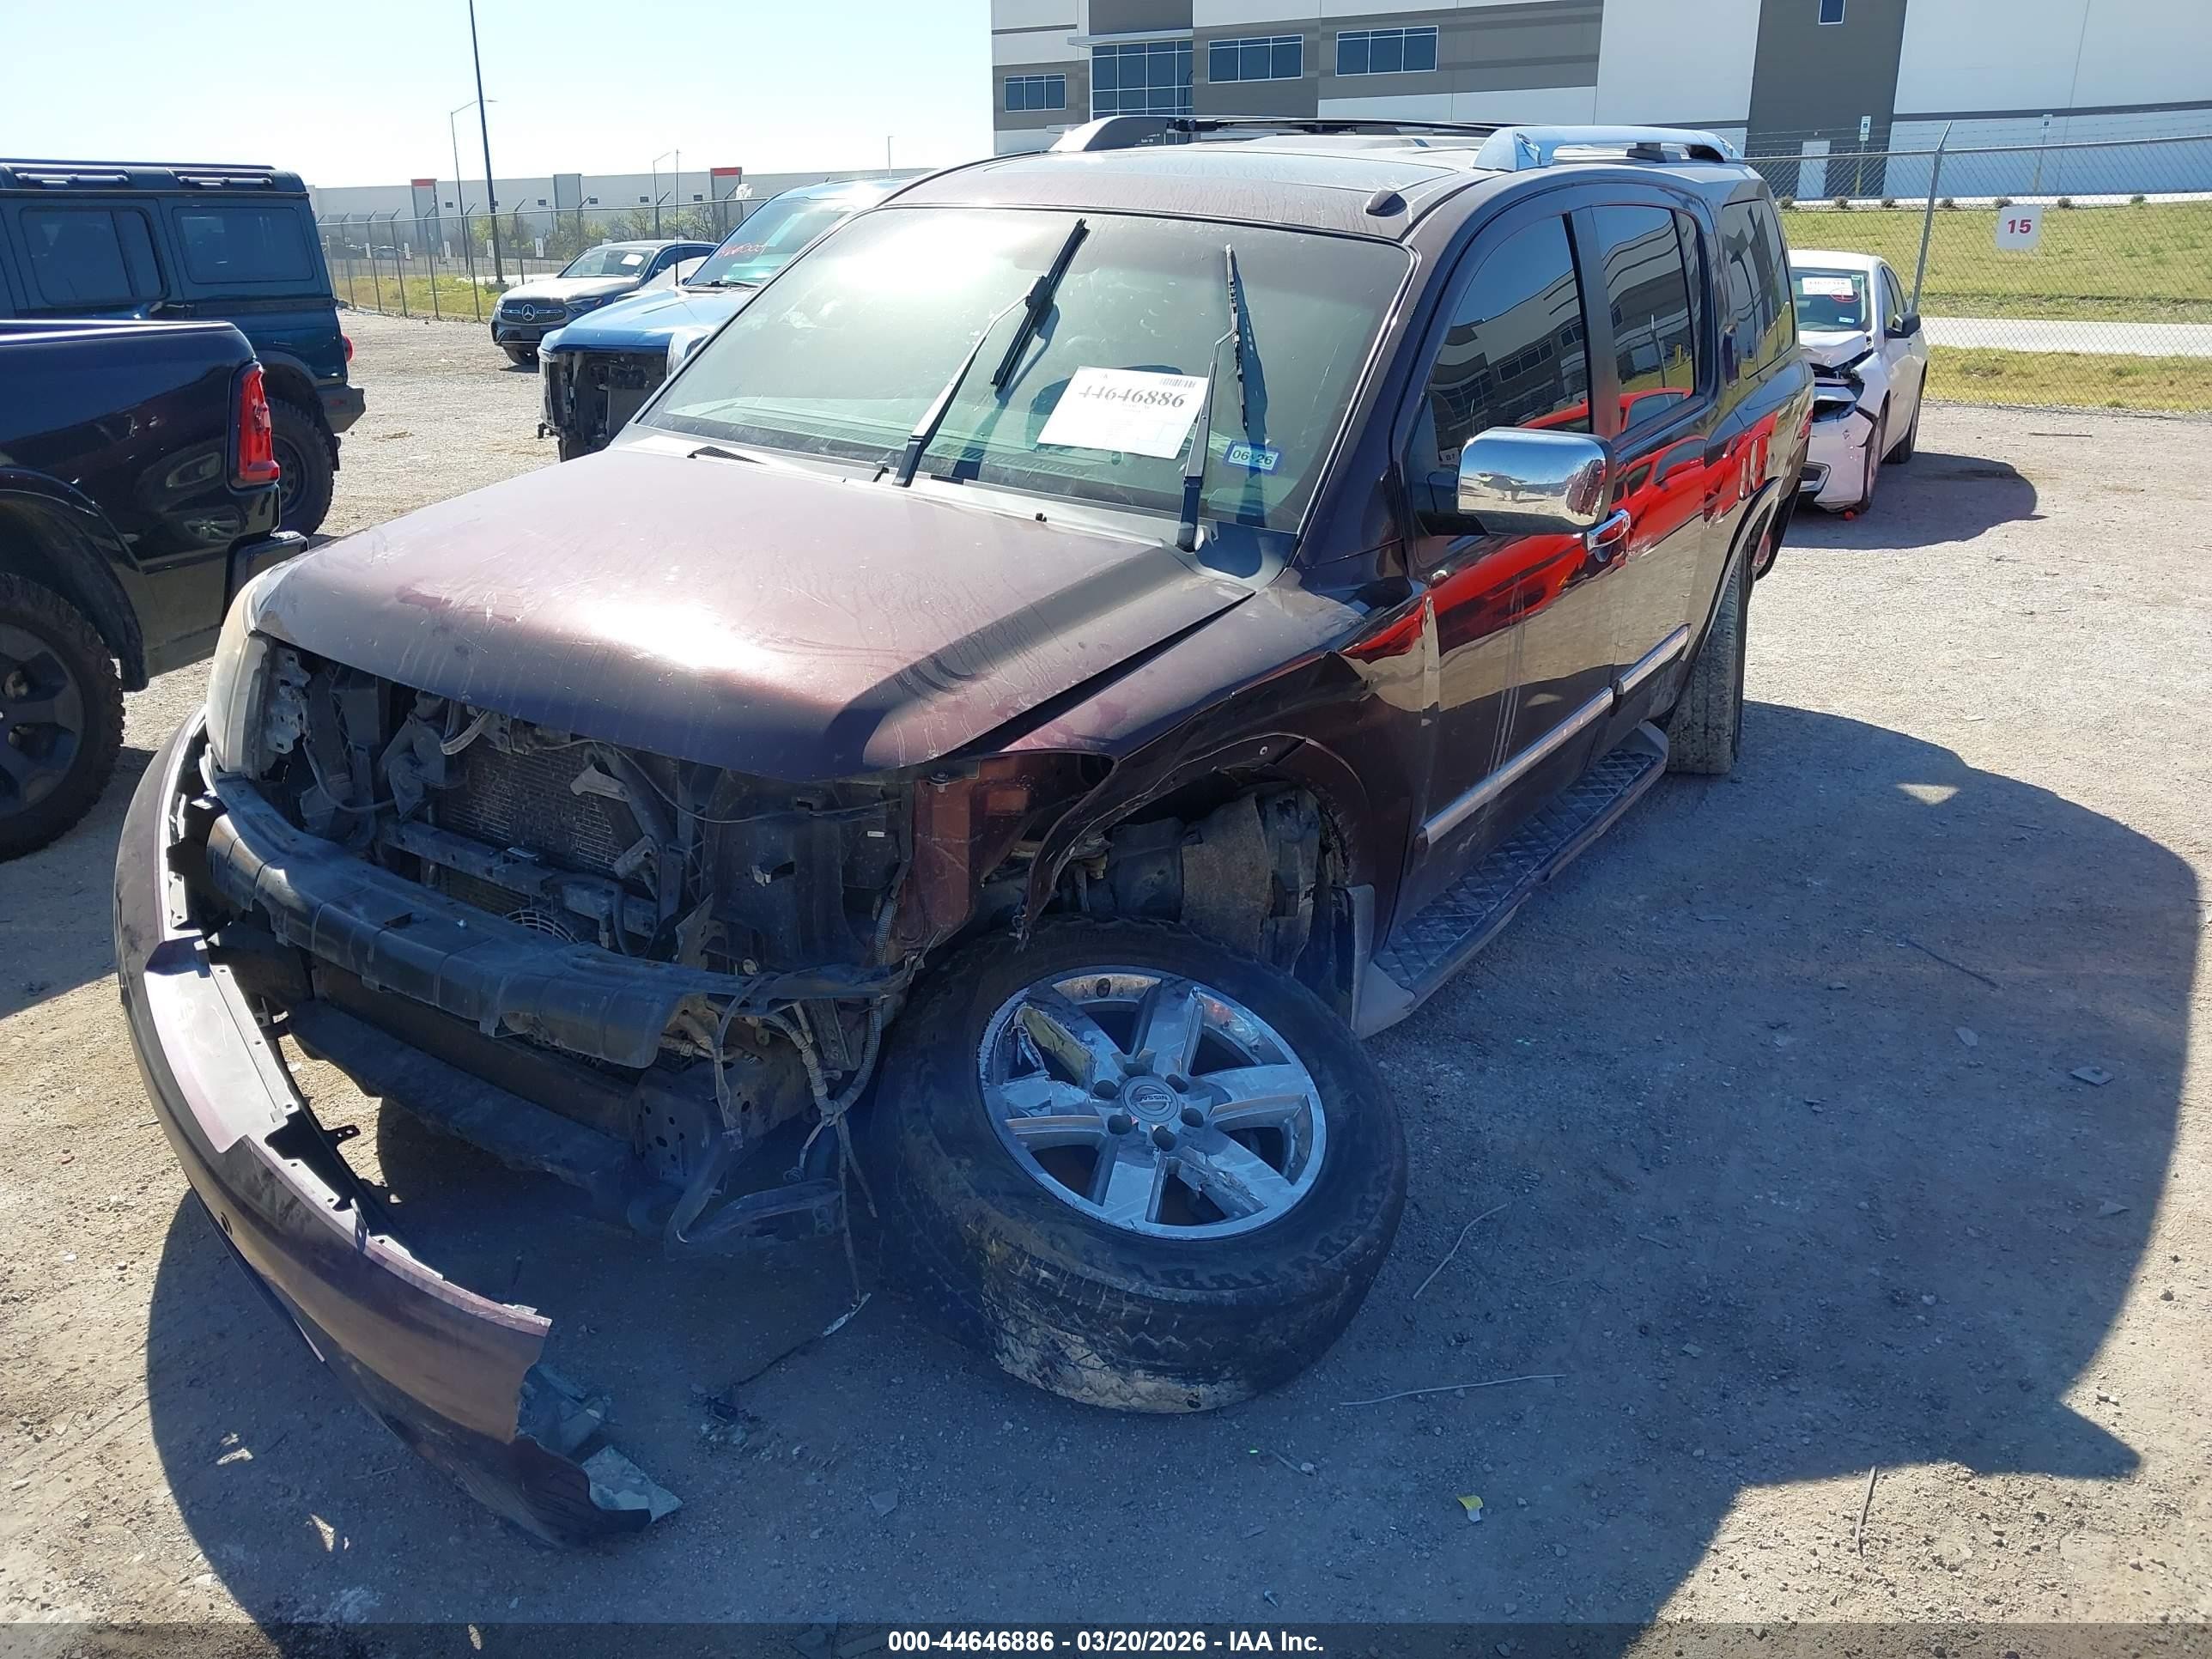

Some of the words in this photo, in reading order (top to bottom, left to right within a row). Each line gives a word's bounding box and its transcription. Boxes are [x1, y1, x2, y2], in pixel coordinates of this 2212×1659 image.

[2008, 219, 2032, 234] 15
[1079, 384, 1188, 408] 44646886
[1232, 449, 1250, 461] 06
[1255, 453, 1273, 465] 26
